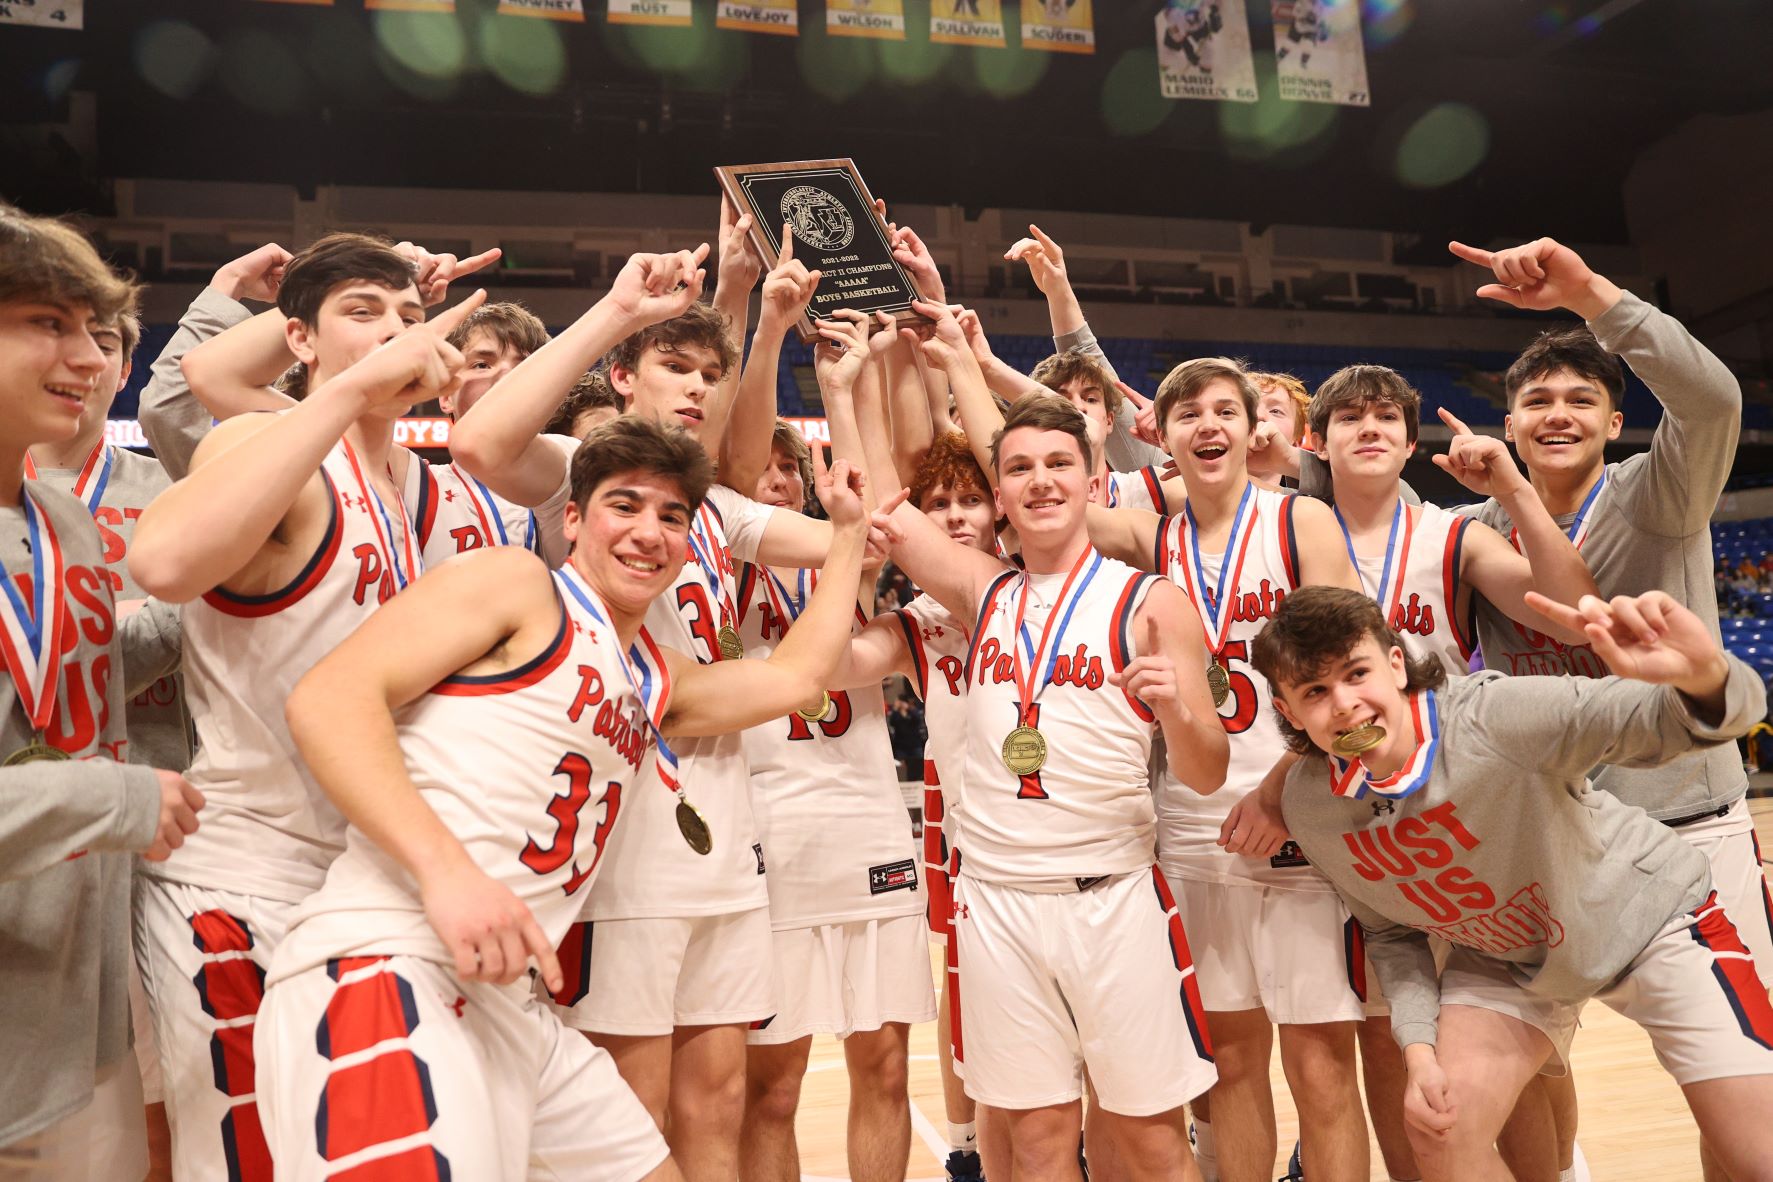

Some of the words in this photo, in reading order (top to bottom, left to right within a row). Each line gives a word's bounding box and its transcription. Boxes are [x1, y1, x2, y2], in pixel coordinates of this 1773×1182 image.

[50, 9, 66, 22] 4
[631, 3, 668, 14] RUST
[725, 7, 790, 23] LOVEJOY
[838, 14, 893, 28] WILSON
[935, 22, 1000, 37] SULLIVAN
[1030, 28, 1087, 43] SCUDERI
[821, 254, 860, 265] 2021-2022
[838, 268, 846, 276] II
[846, 263, 893, 275] CHAMPIONS
[816, 292, 842, 303] BOYS
[842, 285, 900, 300] BASKETBALL
[393, 420, 449, 443] OYS
[1341, 801, 1481, 882] JUST
[1396, 866, 1497, 924] US
